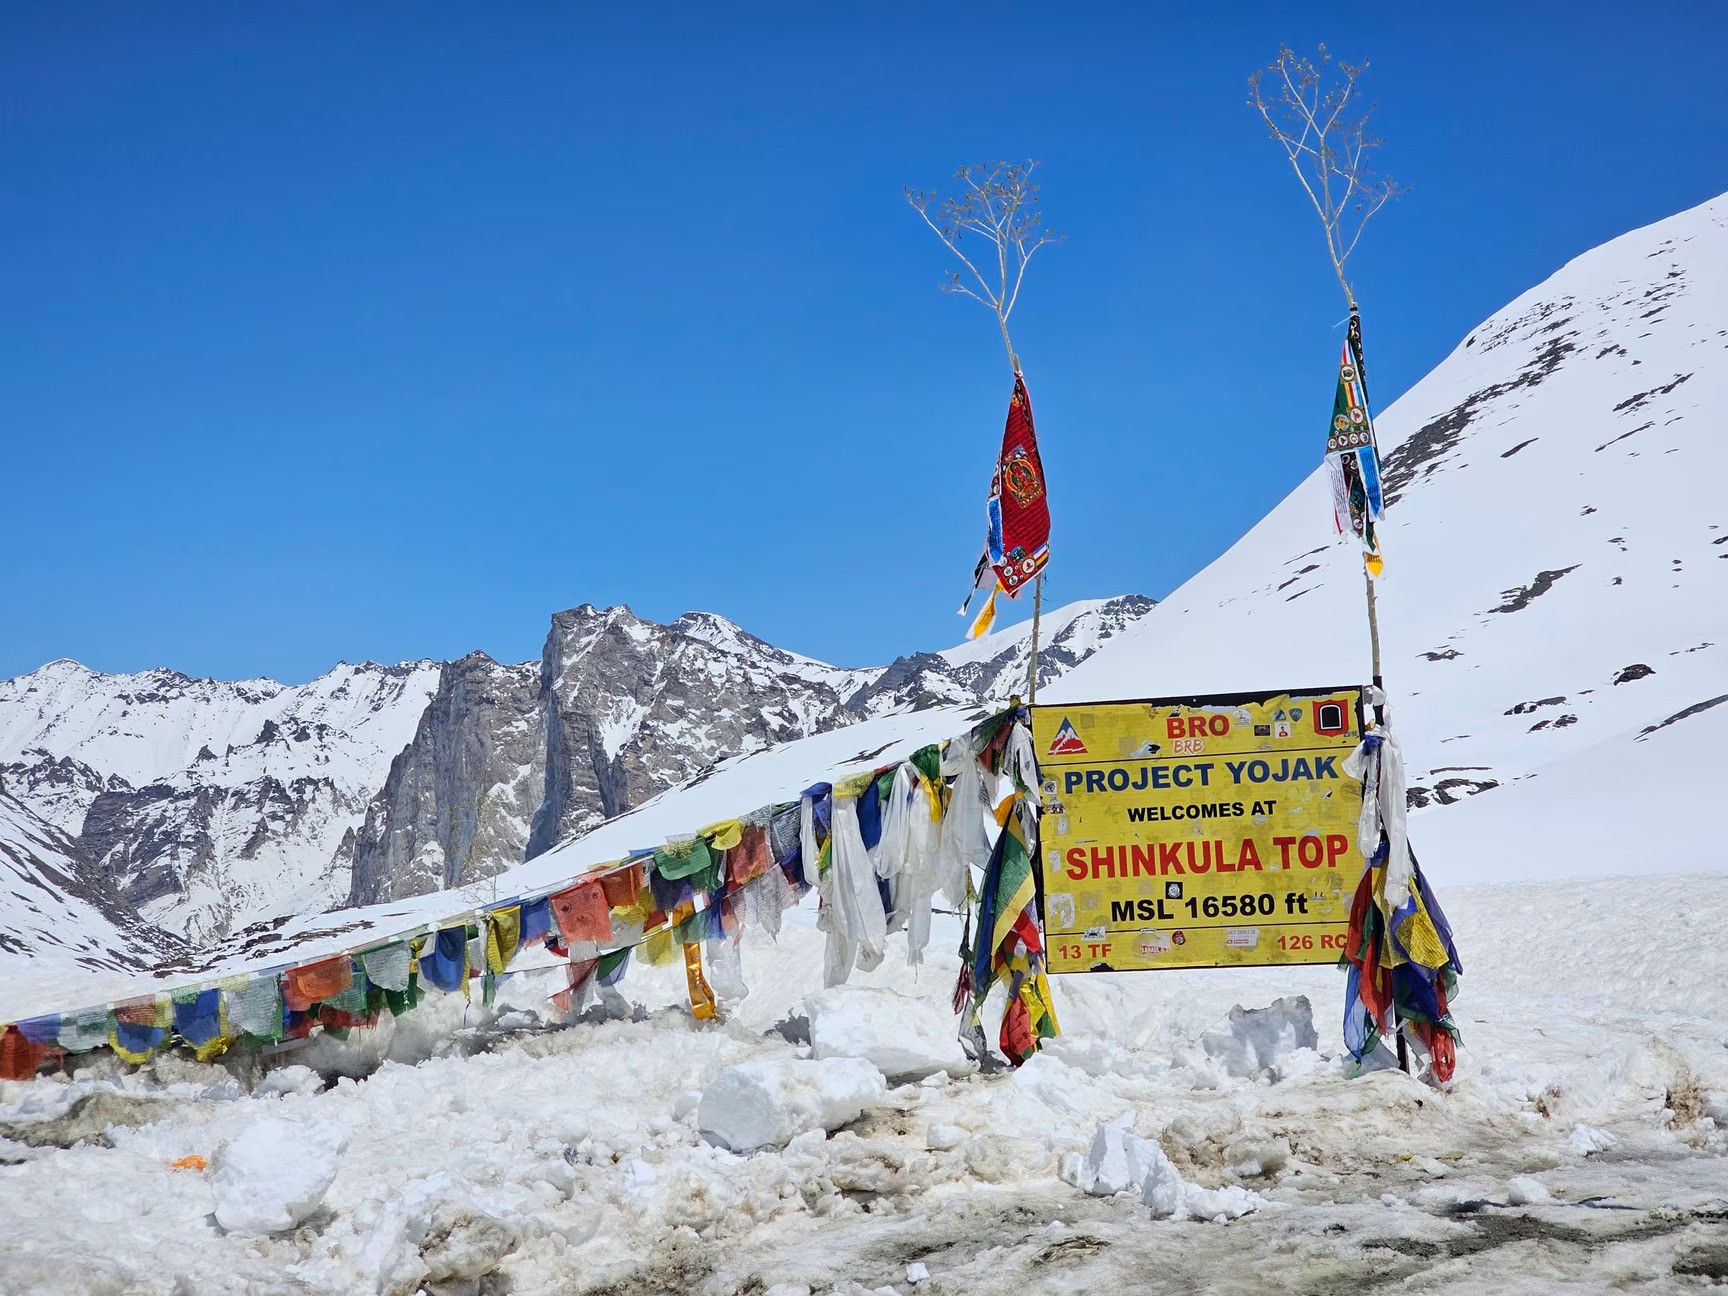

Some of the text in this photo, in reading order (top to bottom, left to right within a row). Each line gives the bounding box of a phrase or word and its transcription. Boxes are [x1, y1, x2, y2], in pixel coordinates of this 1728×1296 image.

[1166, 714, 1231, 740] BRO
[1172, 738, 1204, 755] BRB
[1064, 757, 1338, 795] PROJECT YOJAK
[1127, 800, 1277, 823] WELCOMES AT
[1066, 834, 1349, 880] SHINKULA TOP
[1111, 892, 1309, 922] MSL 16580 ft
[1058, 943, 1112, 960] 13 TF
[1277, 935, 1313, 952] 126
